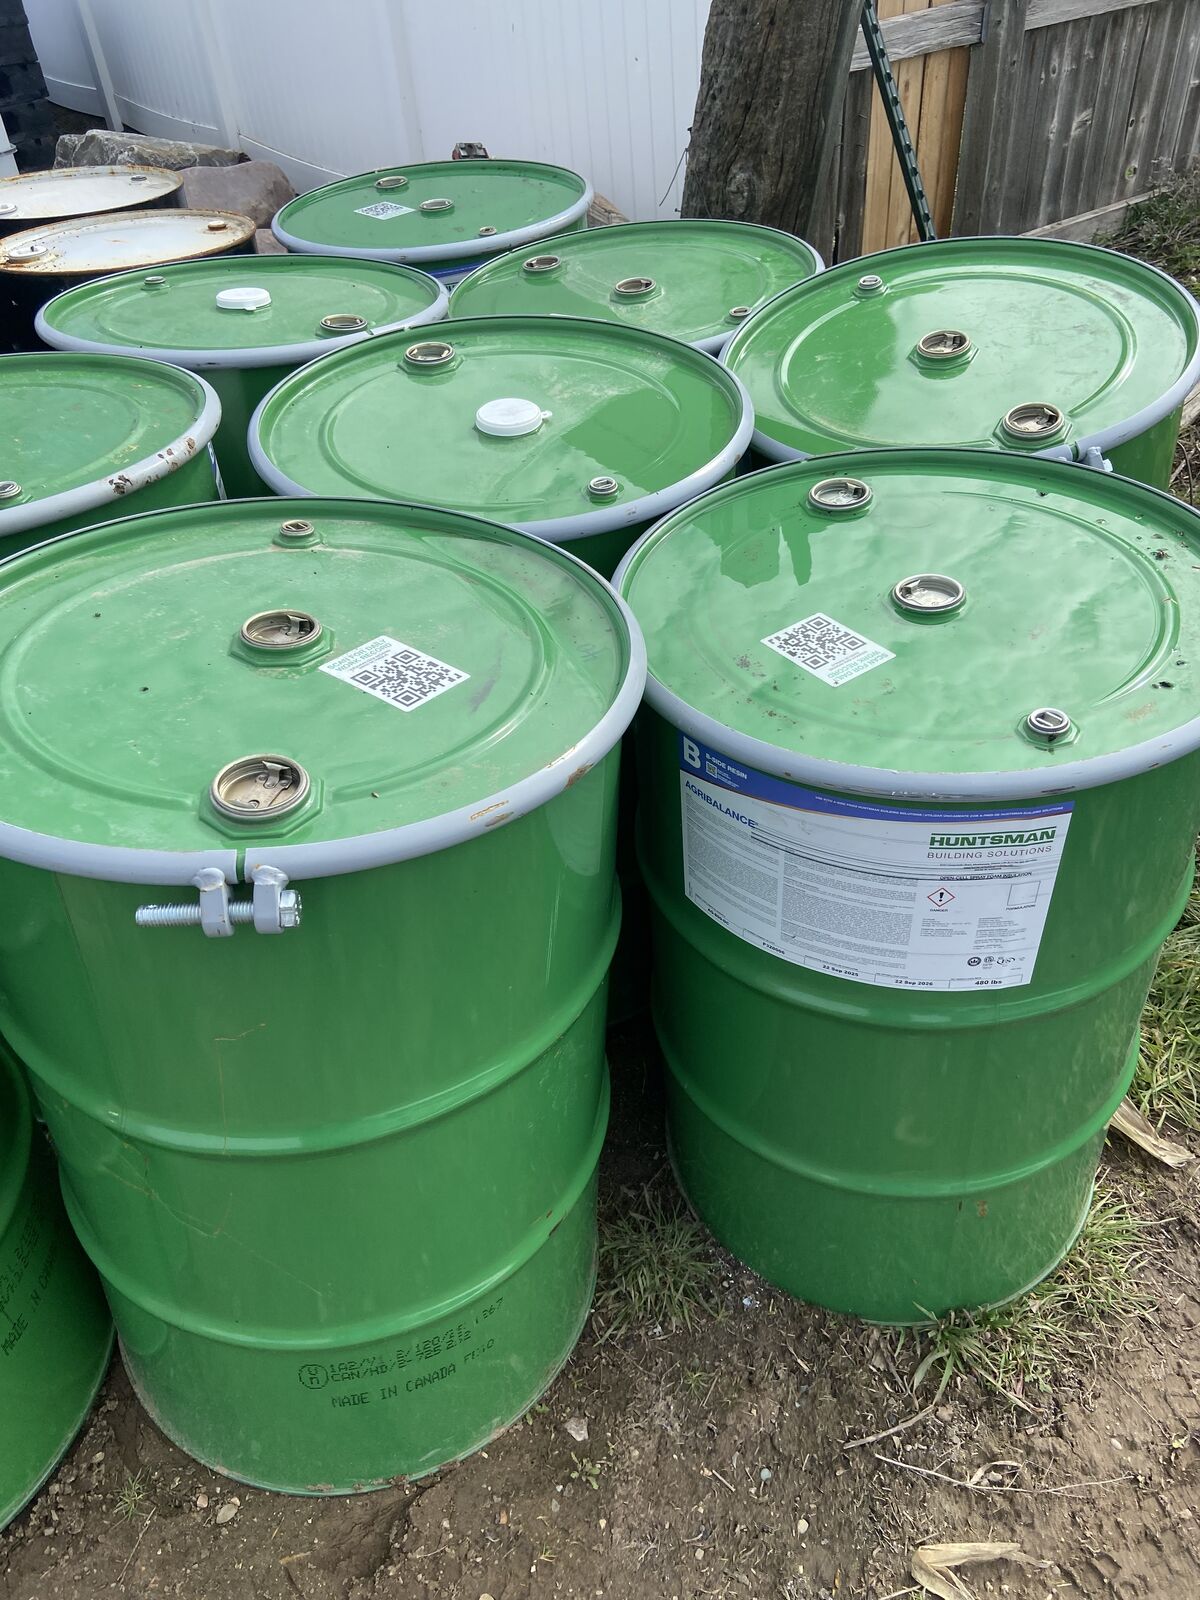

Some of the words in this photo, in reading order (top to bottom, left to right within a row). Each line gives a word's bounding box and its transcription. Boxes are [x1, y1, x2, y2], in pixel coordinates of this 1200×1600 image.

[364, 638, 387, 651] DAILY
[333, 656, 361, 671] WORK
[359, 641, 392, 660] RECORD
[855, 649, 881, 663] WORK
[866, 652, 889, 665] SCAN
[826, 660, 858, 679] RECORD
[851, 662, 869, 673] FOR
[831, 670, 853, 683] DAILY
[683, 735, 701, 769] B
[727, 765, 748, 780] RESIN
[929, 829, 1057, 847] HUNTSMAN
[927, 851, 983, 859] BUILDING
[986, 845, 1053, 858] SOLUTIONS
[1003, 871, 1032, 879] INSULATION
[831, 966, 843, 975] Sep
[844, 969, 859, 977] 2025
[331, 1392, 371, 1409] MADE
[380, 1384, 398, 1400] IN
[405, 1362, 456, 1393] CANADA
